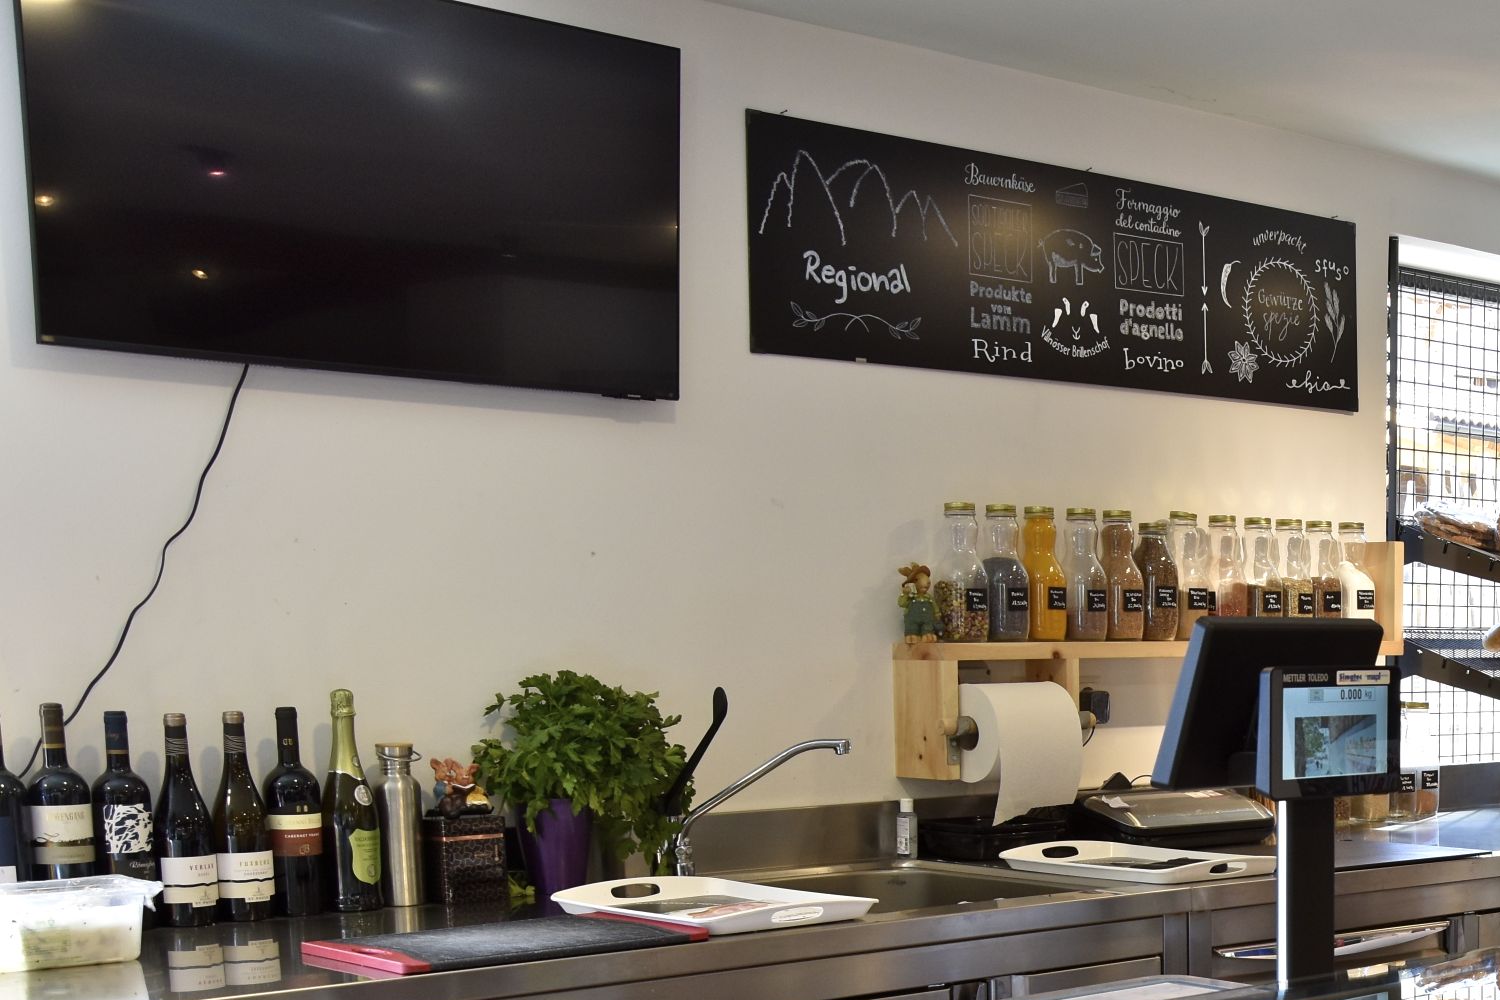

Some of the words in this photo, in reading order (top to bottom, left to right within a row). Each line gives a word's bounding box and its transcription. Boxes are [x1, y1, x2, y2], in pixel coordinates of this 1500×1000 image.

[964, 163, 1036, 192] Bauernkäse
[1115, 188, 1181, 221] Formaggio
[1116, 214, 1134, 231] del
[1134, 218, 1182, 238] contadino
[972, 231, 1028, 277] SPECK
[1117, 240, 1179, 291] SPECK
[803, 250, 911, 304] Regional
[970, 281, 1032, 303] Produkte
[1257, 288, 1303, 312] Gewürze
[970, 307, 1031, 335] Lamm
[991, 304, 1012, 315] vom
[1119, 298, 1183, 321] Prodotti
[1119, 318, 1184, 342] d'agnello
[971, 338, 1033, 363] Rind
[1123, 347, 1184, 373] bovino
[1283, 674, 1306, 682] METTLER
[1308, 673, 1328, 682] TOLEDO
[1340, 688, 1362, 700] 0.000
[1364, 690, 1372, 699] kg
